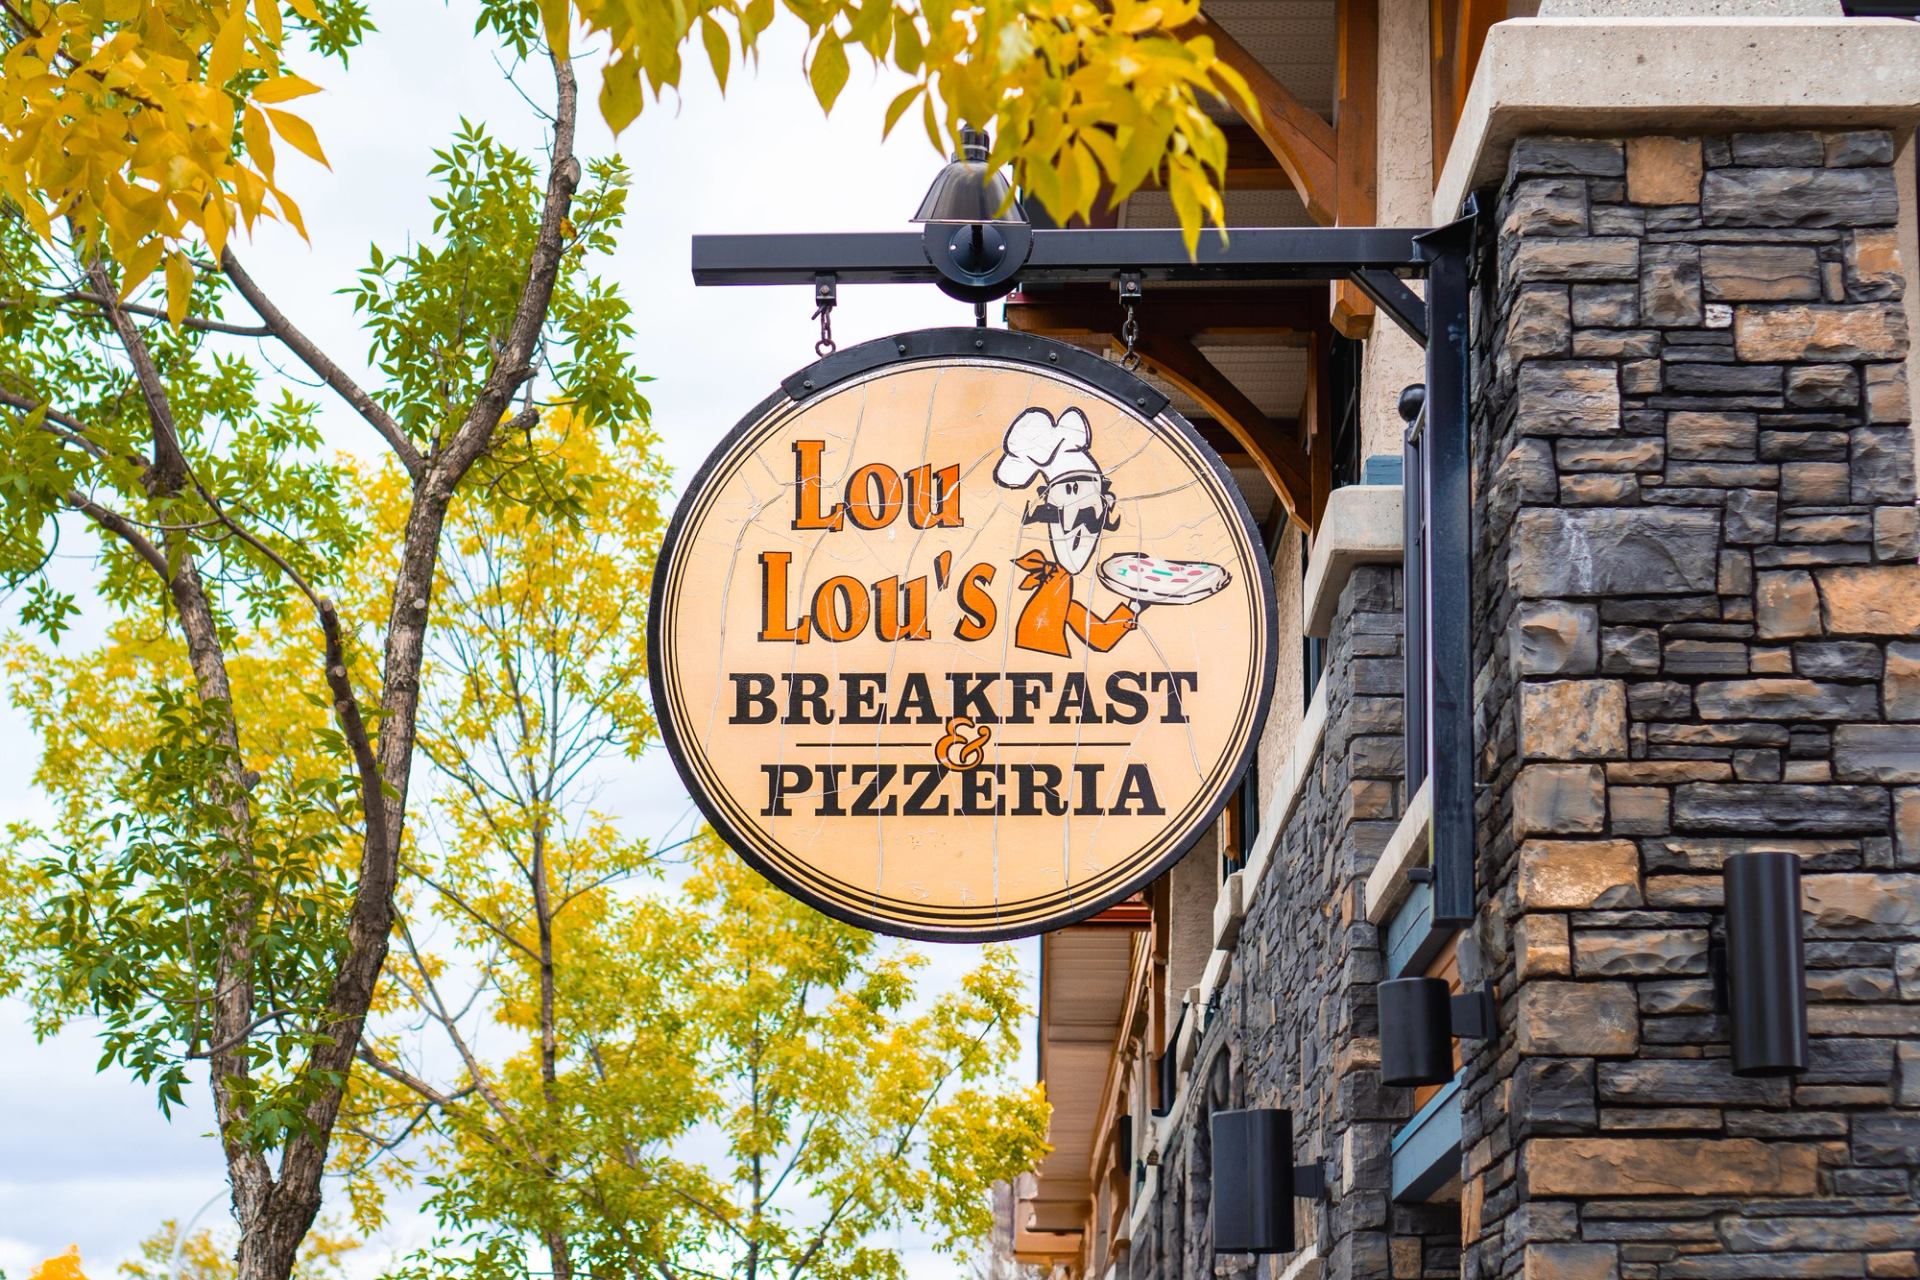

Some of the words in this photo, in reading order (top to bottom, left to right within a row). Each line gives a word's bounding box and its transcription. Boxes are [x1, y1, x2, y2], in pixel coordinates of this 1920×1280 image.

[791, 439, 965, 533] Lou
[757, 550, 998, 645] Lou's
[728, 671, 1199, 726] BREAKFAST
[935, 716, 991, 772] &
[759, 763, 1167, 817] PIZZERIA
